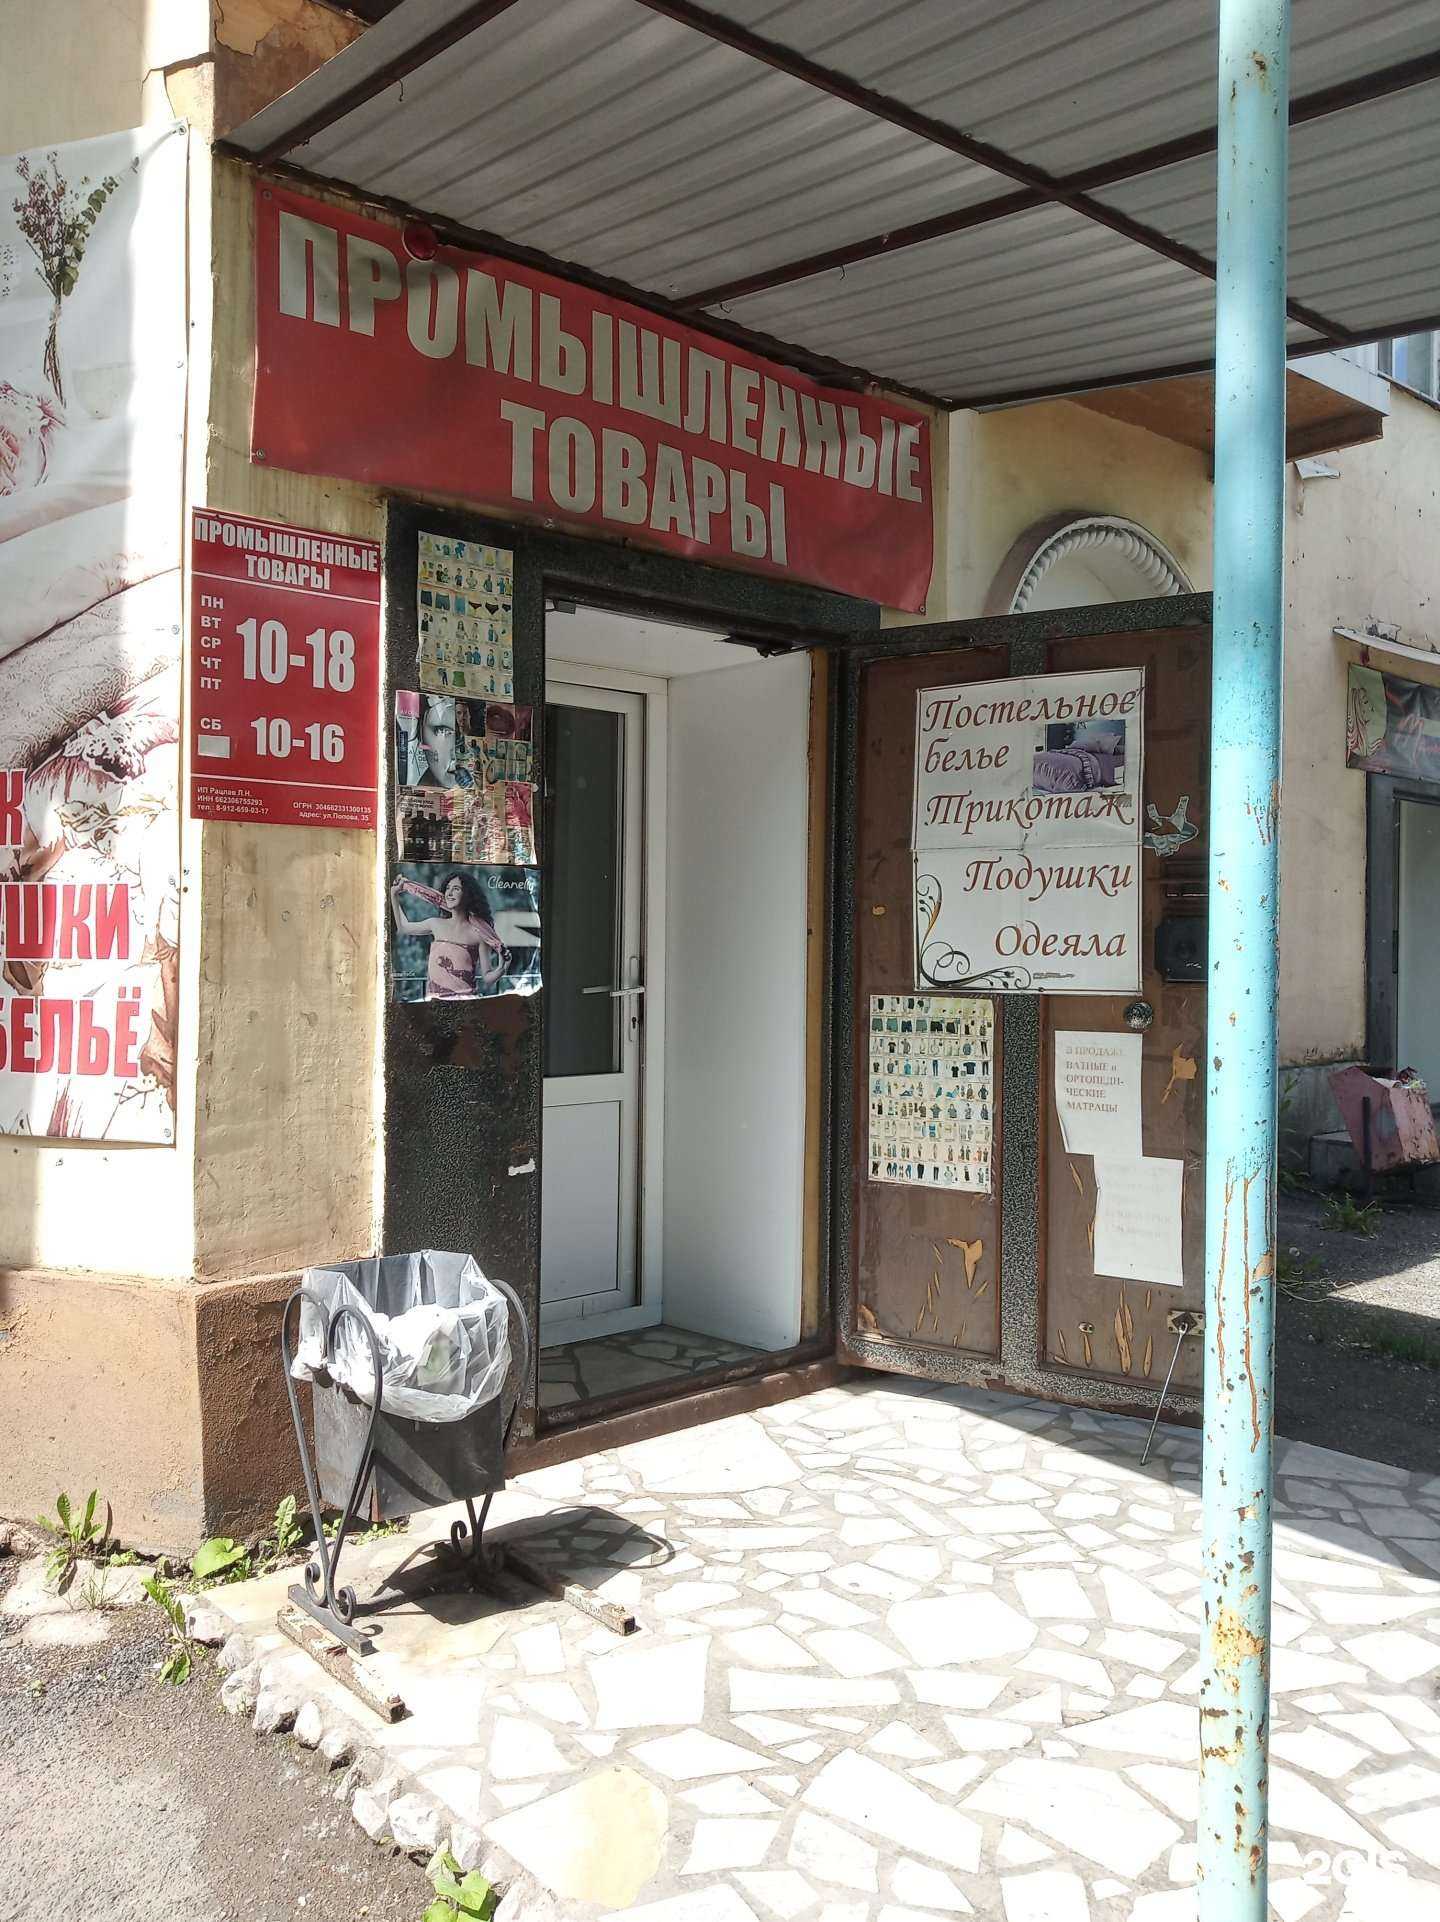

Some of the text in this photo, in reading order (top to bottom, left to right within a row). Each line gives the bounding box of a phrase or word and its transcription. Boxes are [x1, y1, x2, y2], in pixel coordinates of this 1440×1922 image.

[279, 210, 922, 503] ПРОМЫШЛЕННЫЕ
[501, 399, 788, 566] ТОВАРЫ
[194, 517, 378, 572] ПРОМЫШЛЕННЫЕ
[245, 554, 331, 590] ТОВАРЫ
[200, 594, 224, 609] ПН
[200, 615, 222, 629] ВТ
[200, 636, 222, 649] СР
[236, 617, 356, 692] 10-18
[200, 656, 222, 670] ЧТ
[200, 677, 222, 690] ПТ
[200, 717, 222, 730] СБ
[923, 686, 1144, 732] Постельное
[250, 716, 345, 763] 10-16
[924, 737, 1010, 773] белье
[924, 789, 1134, 835] Трикотаж
[963, 853, 1132, 901] Подушки
[0, 884, 129, 959] ШКИ
[995, 920, 1127, 957] Одеяла
[1066, 1061, 1107, 1071] ВАТНЫЕ
[1066, 1087, 1107, 1098] ЧЕСКИЕ
[1067, 1101, 1120, 1112] МАТРАЦЫ
